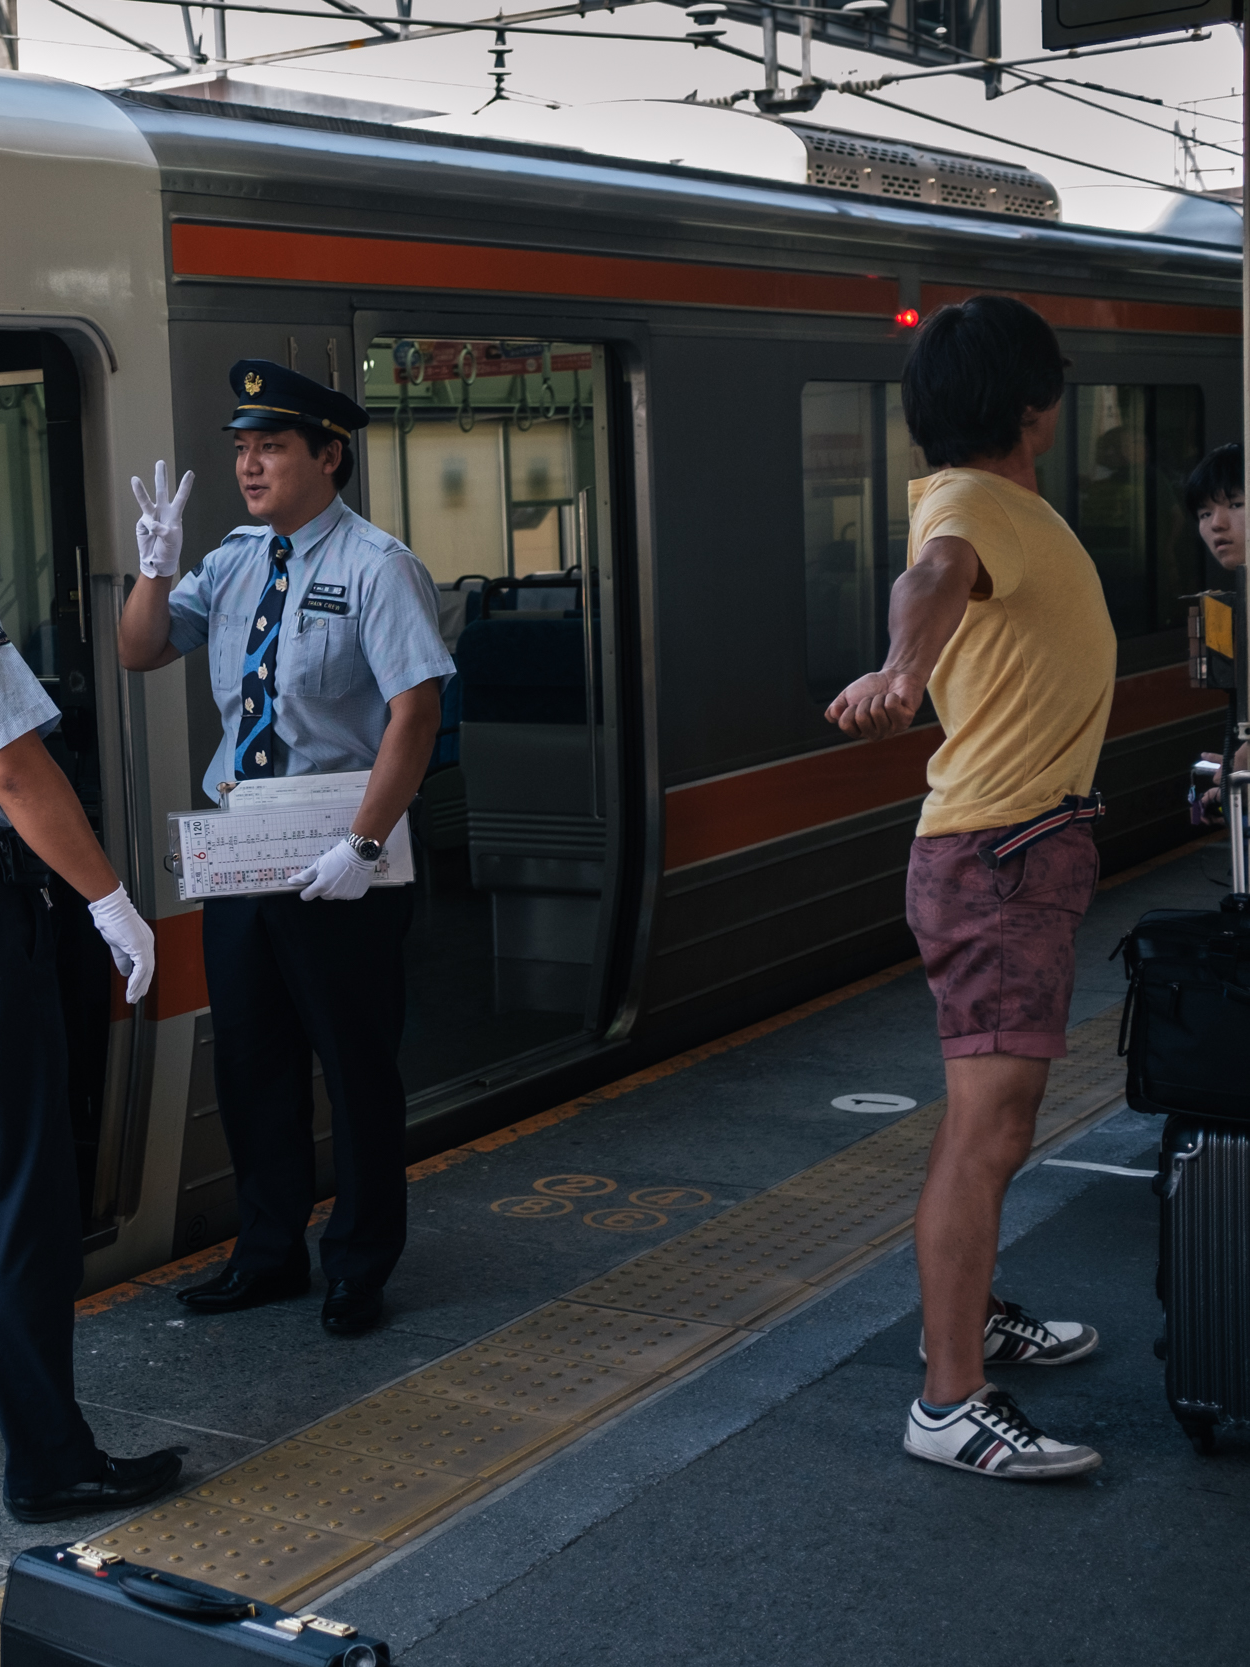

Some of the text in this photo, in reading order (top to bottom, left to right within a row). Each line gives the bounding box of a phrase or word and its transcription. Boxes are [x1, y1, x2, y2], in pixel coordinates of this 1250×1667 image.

[324, 602, 341, 611] CREW
[193, 821, 202, 836] 120
[193, 852, 206, 860] 6
[551, 1177, 596, 1194] 2
[645, 1190, 687, 1205] 4
[511, 1199, 552, 1214] 8
[603, 1211, 645, 1227] 6
